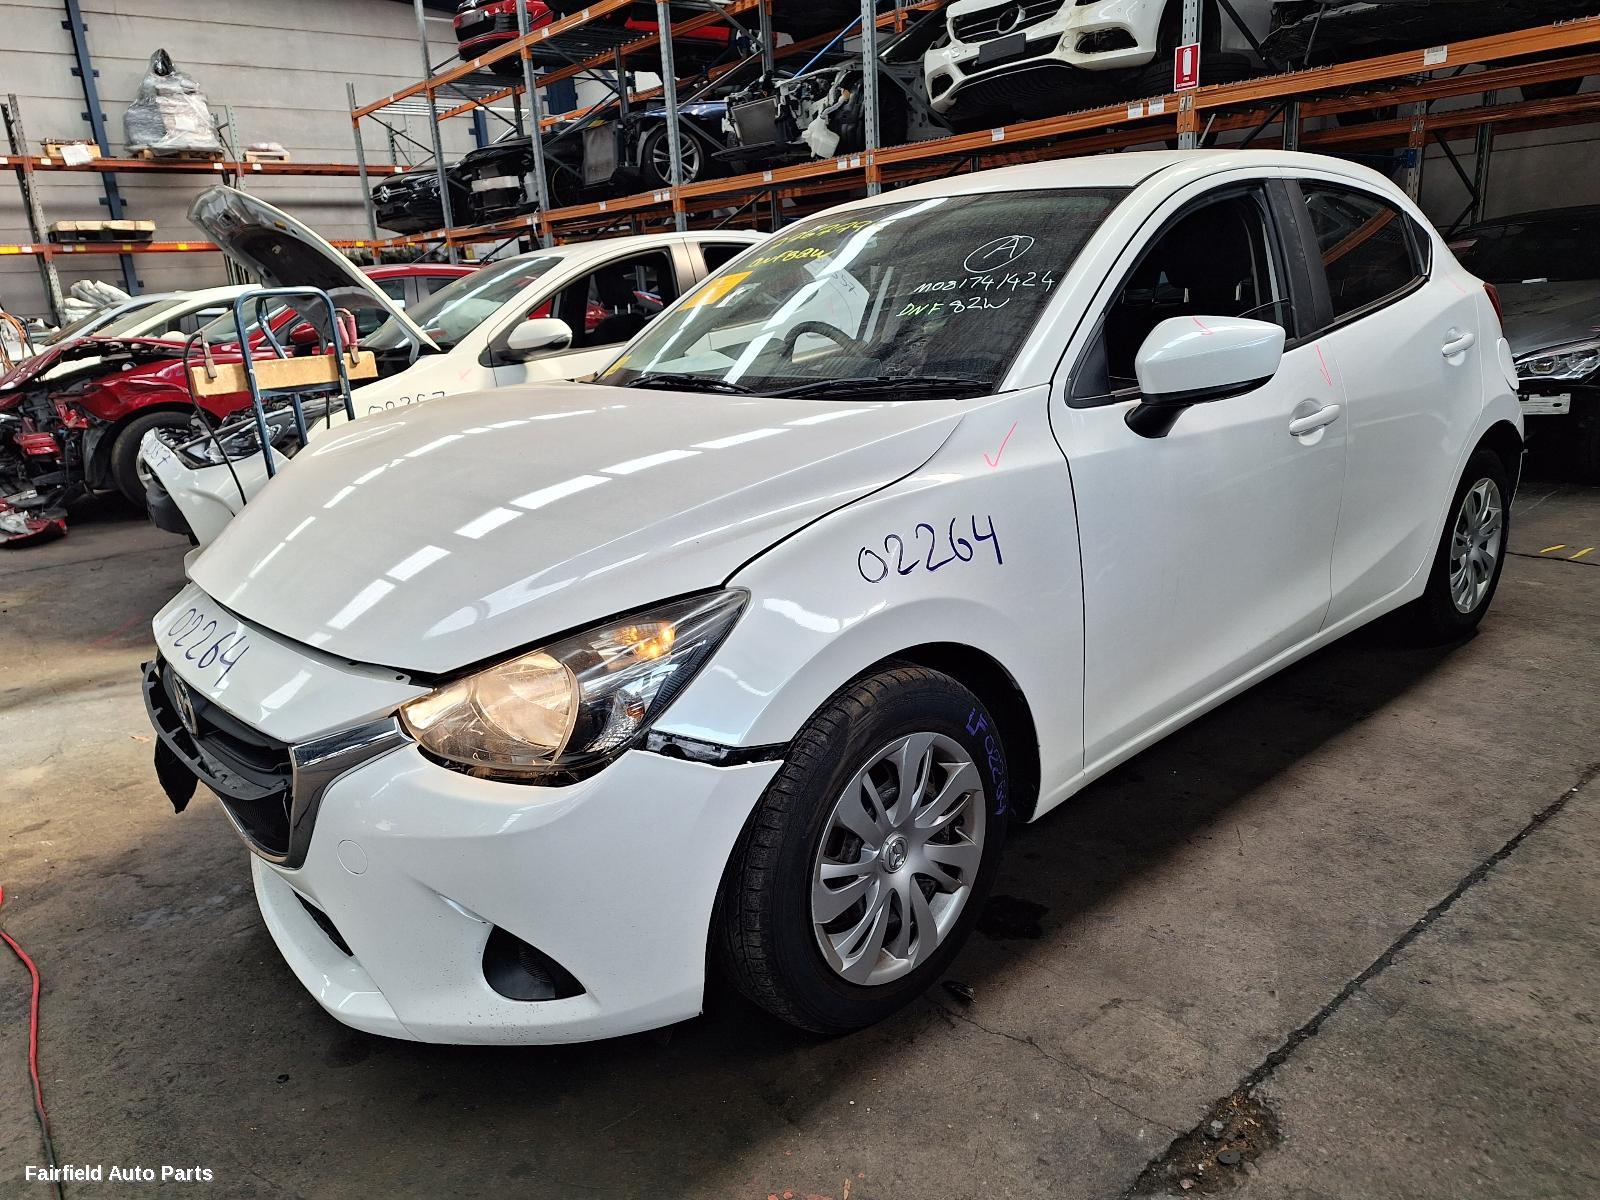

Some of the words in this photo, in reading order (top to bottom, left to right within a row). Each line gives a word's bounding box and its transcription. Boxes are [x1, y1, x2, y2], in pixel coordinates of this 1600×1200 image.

[982, 234, 1020, 259] A
[896, 302, 945, 317] DNF
[949, 296, 1010, 313] 82W
[857, 514, 1003, 583] 02264
[168, 608, 250, 687] 02264
[965, 706, 988, 736] LF
